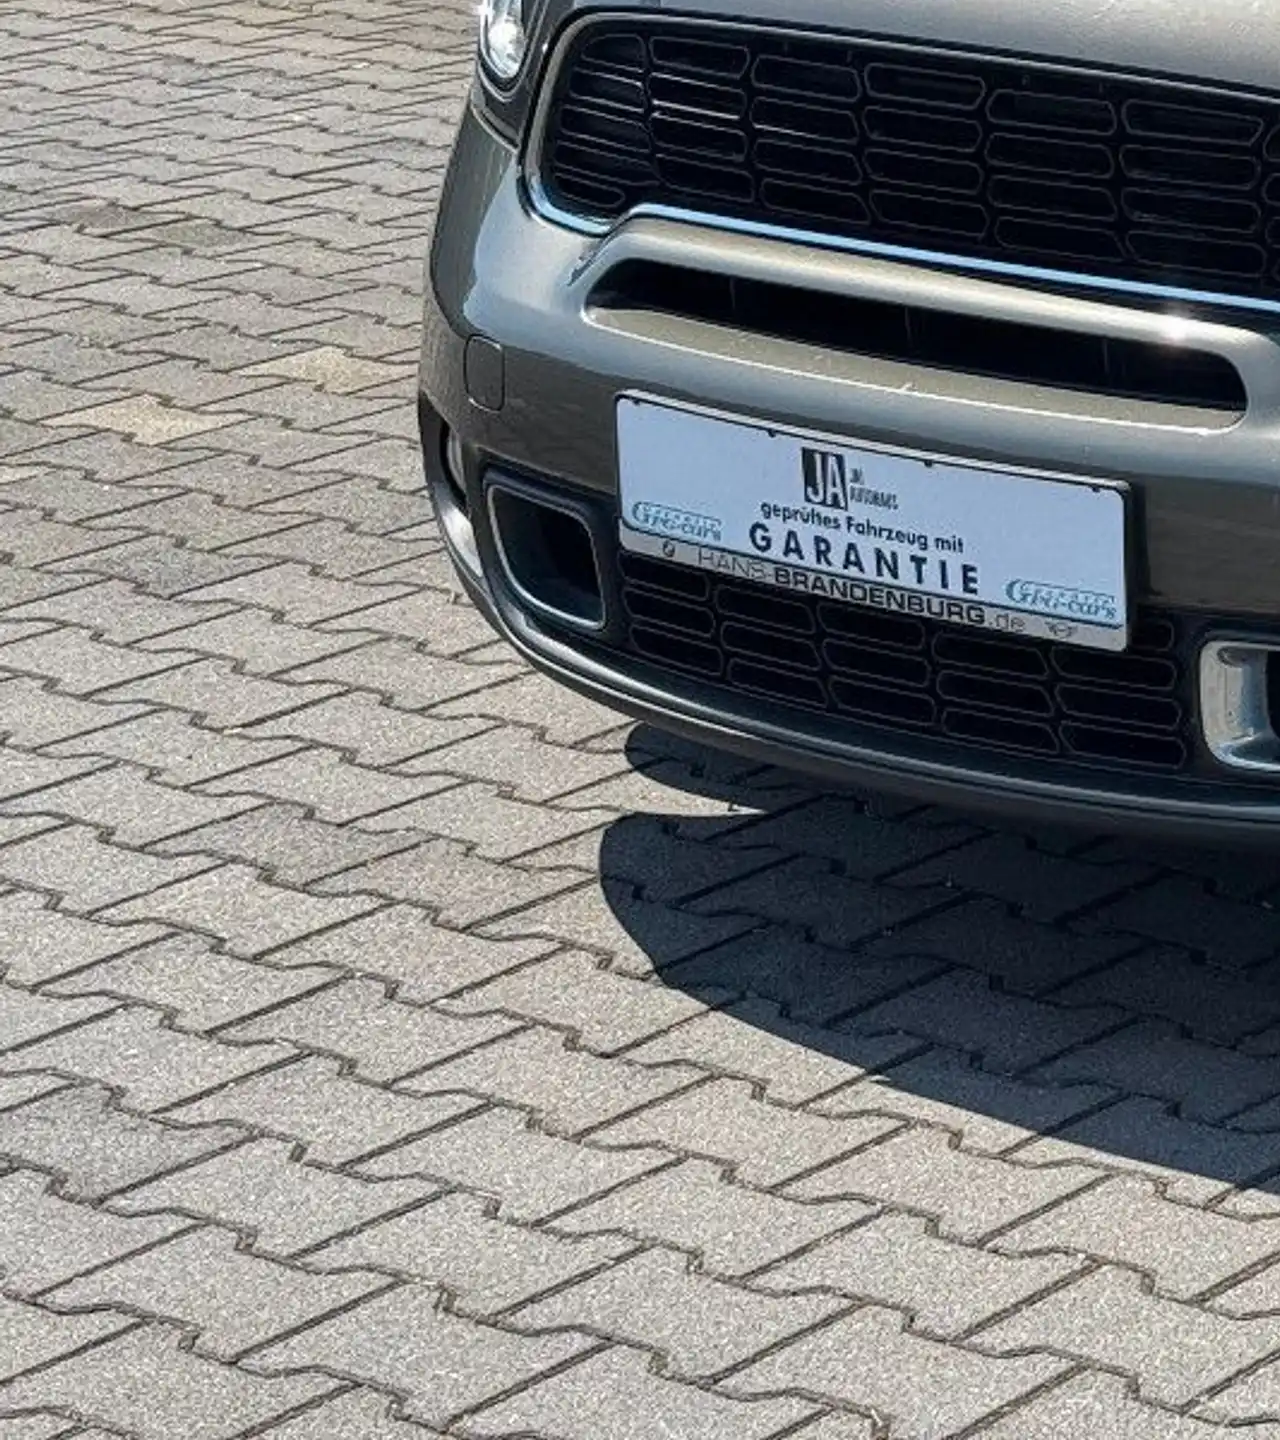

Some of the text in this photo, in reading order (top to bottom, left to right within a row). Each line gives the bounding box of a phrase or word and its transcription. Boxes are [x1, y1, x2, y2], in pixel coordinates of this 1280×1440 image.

[806, 451, 846, 510] JA
[760, 502, 964, 554] geprüftes Fahrzeug mit
[749, 521, 979, 595] GARANTIE
